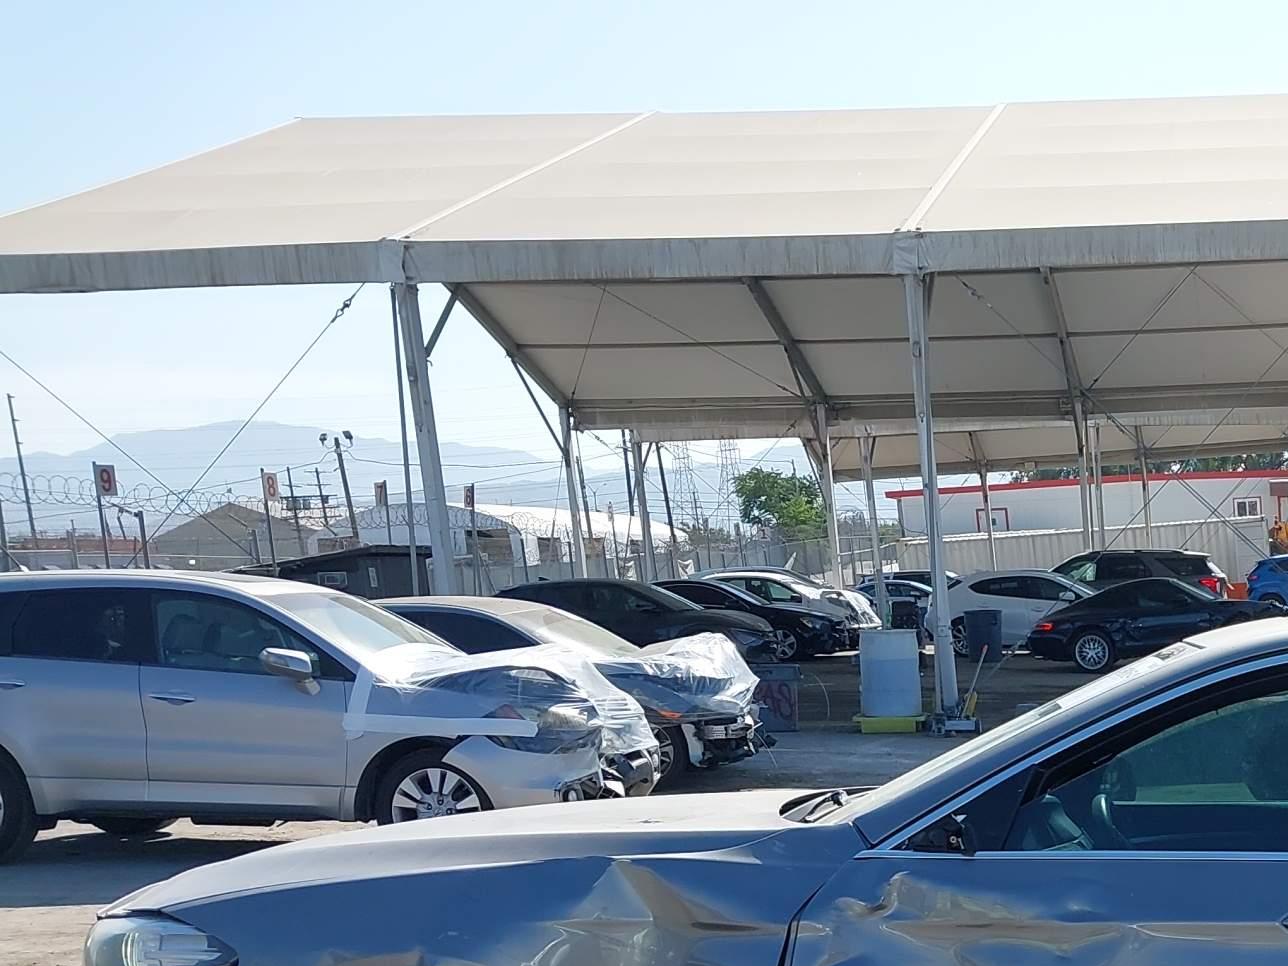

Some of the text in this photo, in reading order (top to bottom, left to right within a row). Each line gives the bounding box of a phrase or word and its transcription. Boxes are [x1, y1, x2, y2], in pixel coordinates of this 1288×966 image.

[100, 468, 112, 493] 9
[266, 475, 276, 498] 8
[376, 484, 385, 505] 7
[465, 488, 473, 506] 6
